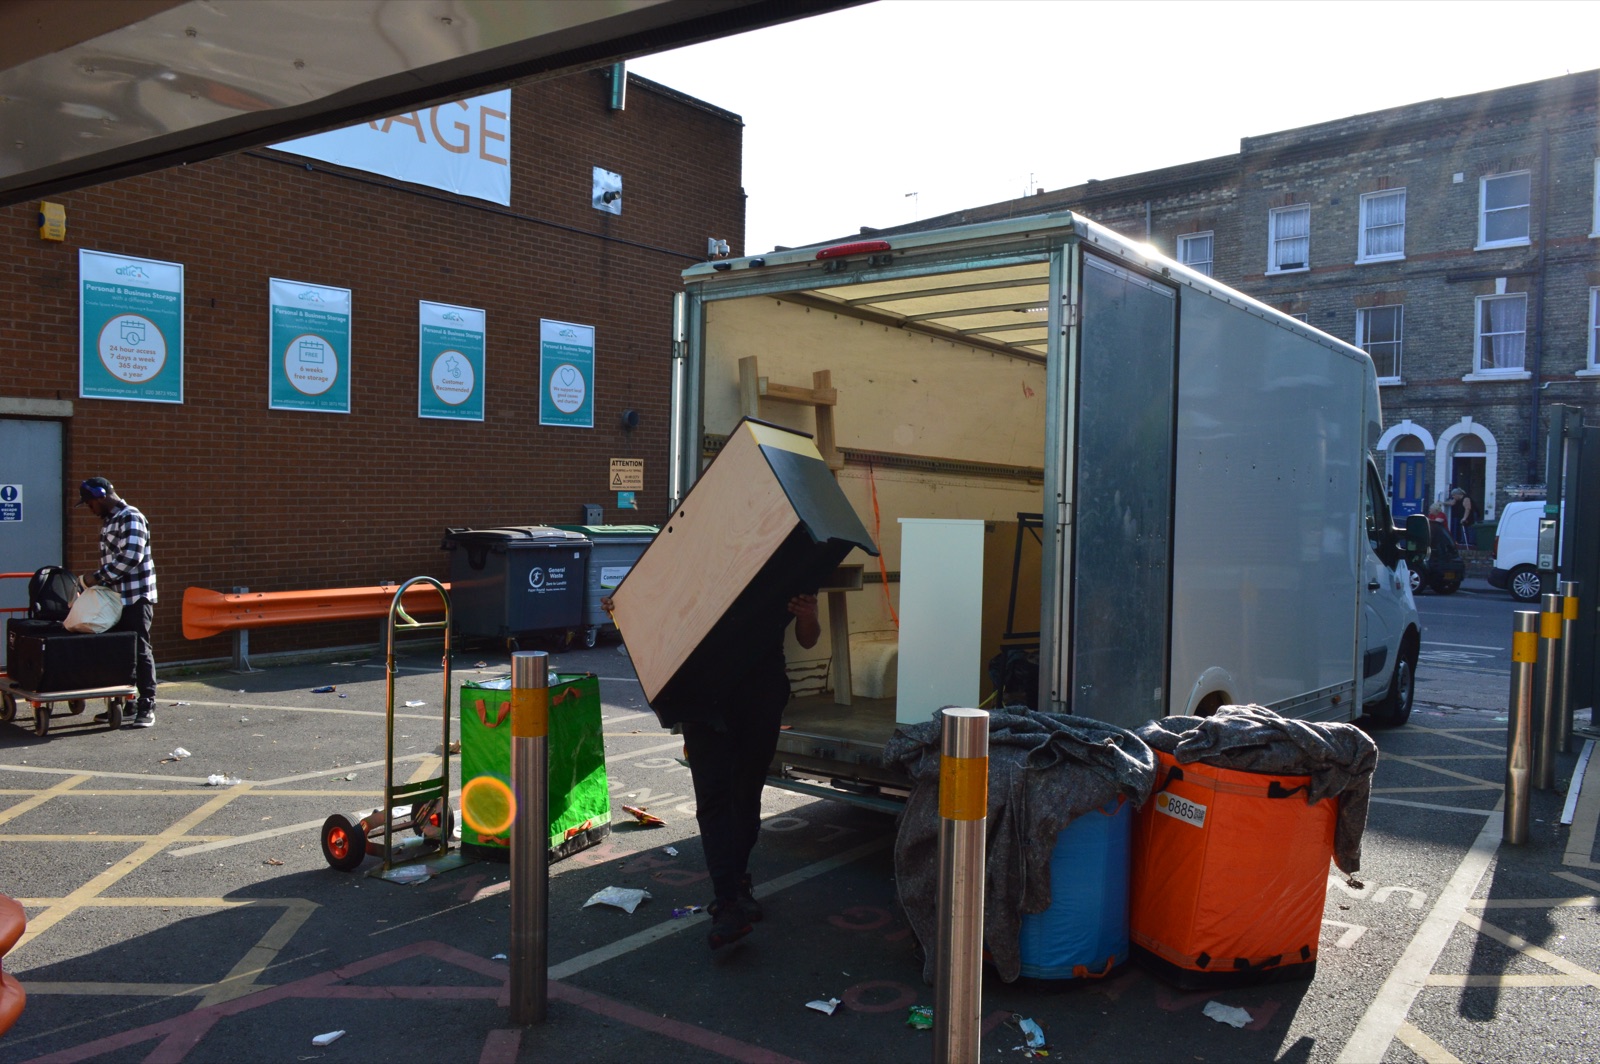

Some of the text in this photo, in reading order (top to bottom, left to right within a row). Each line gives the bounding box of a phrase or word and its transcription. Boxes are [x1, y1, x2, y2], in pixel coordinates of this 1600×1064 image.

[86, 284, 115, 293] Personal
[123, 288, 151, 298] Business
[152, 292, 176, 302] Storage
[275, 308, 298, 316] Personal
[304, 311, 326, 320] Business
[327, 314, 346, 323] Storage
[119, 346, 134, 354] hour
[116, 354, 131, 362] days
[132, 363, 147, 371] days
[128, 371, 143, 379] year
[307, 374, 328, 382] storage
[442, 378, 464, 386] Customer
[436, 384, 470, 393] Recommended
[1168, 797, 1194, 819] 6885
